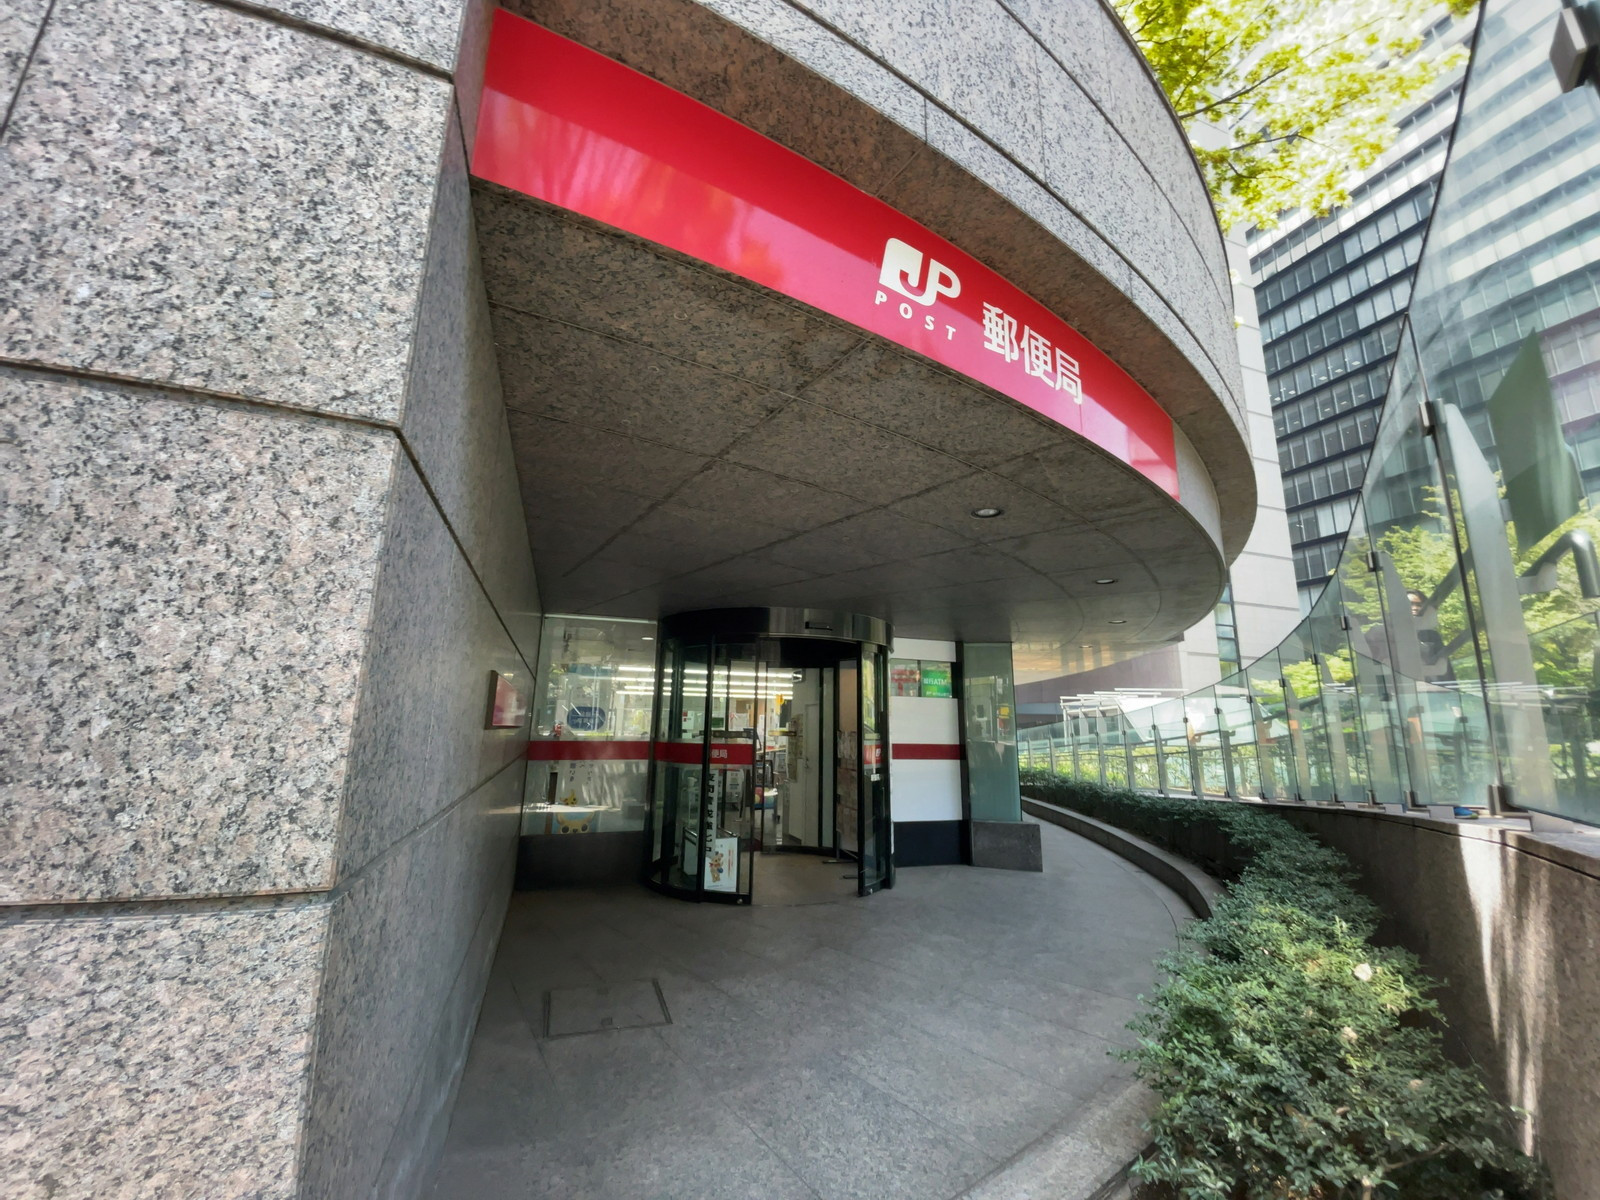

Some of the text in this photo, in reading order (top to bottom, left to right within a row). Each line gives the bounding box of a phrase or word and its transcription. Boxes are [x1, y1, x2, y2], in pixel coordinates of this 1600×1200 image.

[879, 238, 961, 306] JP
[875, 290, 956, 340] POST
[983, 301, 1082, 405] 郵便局
